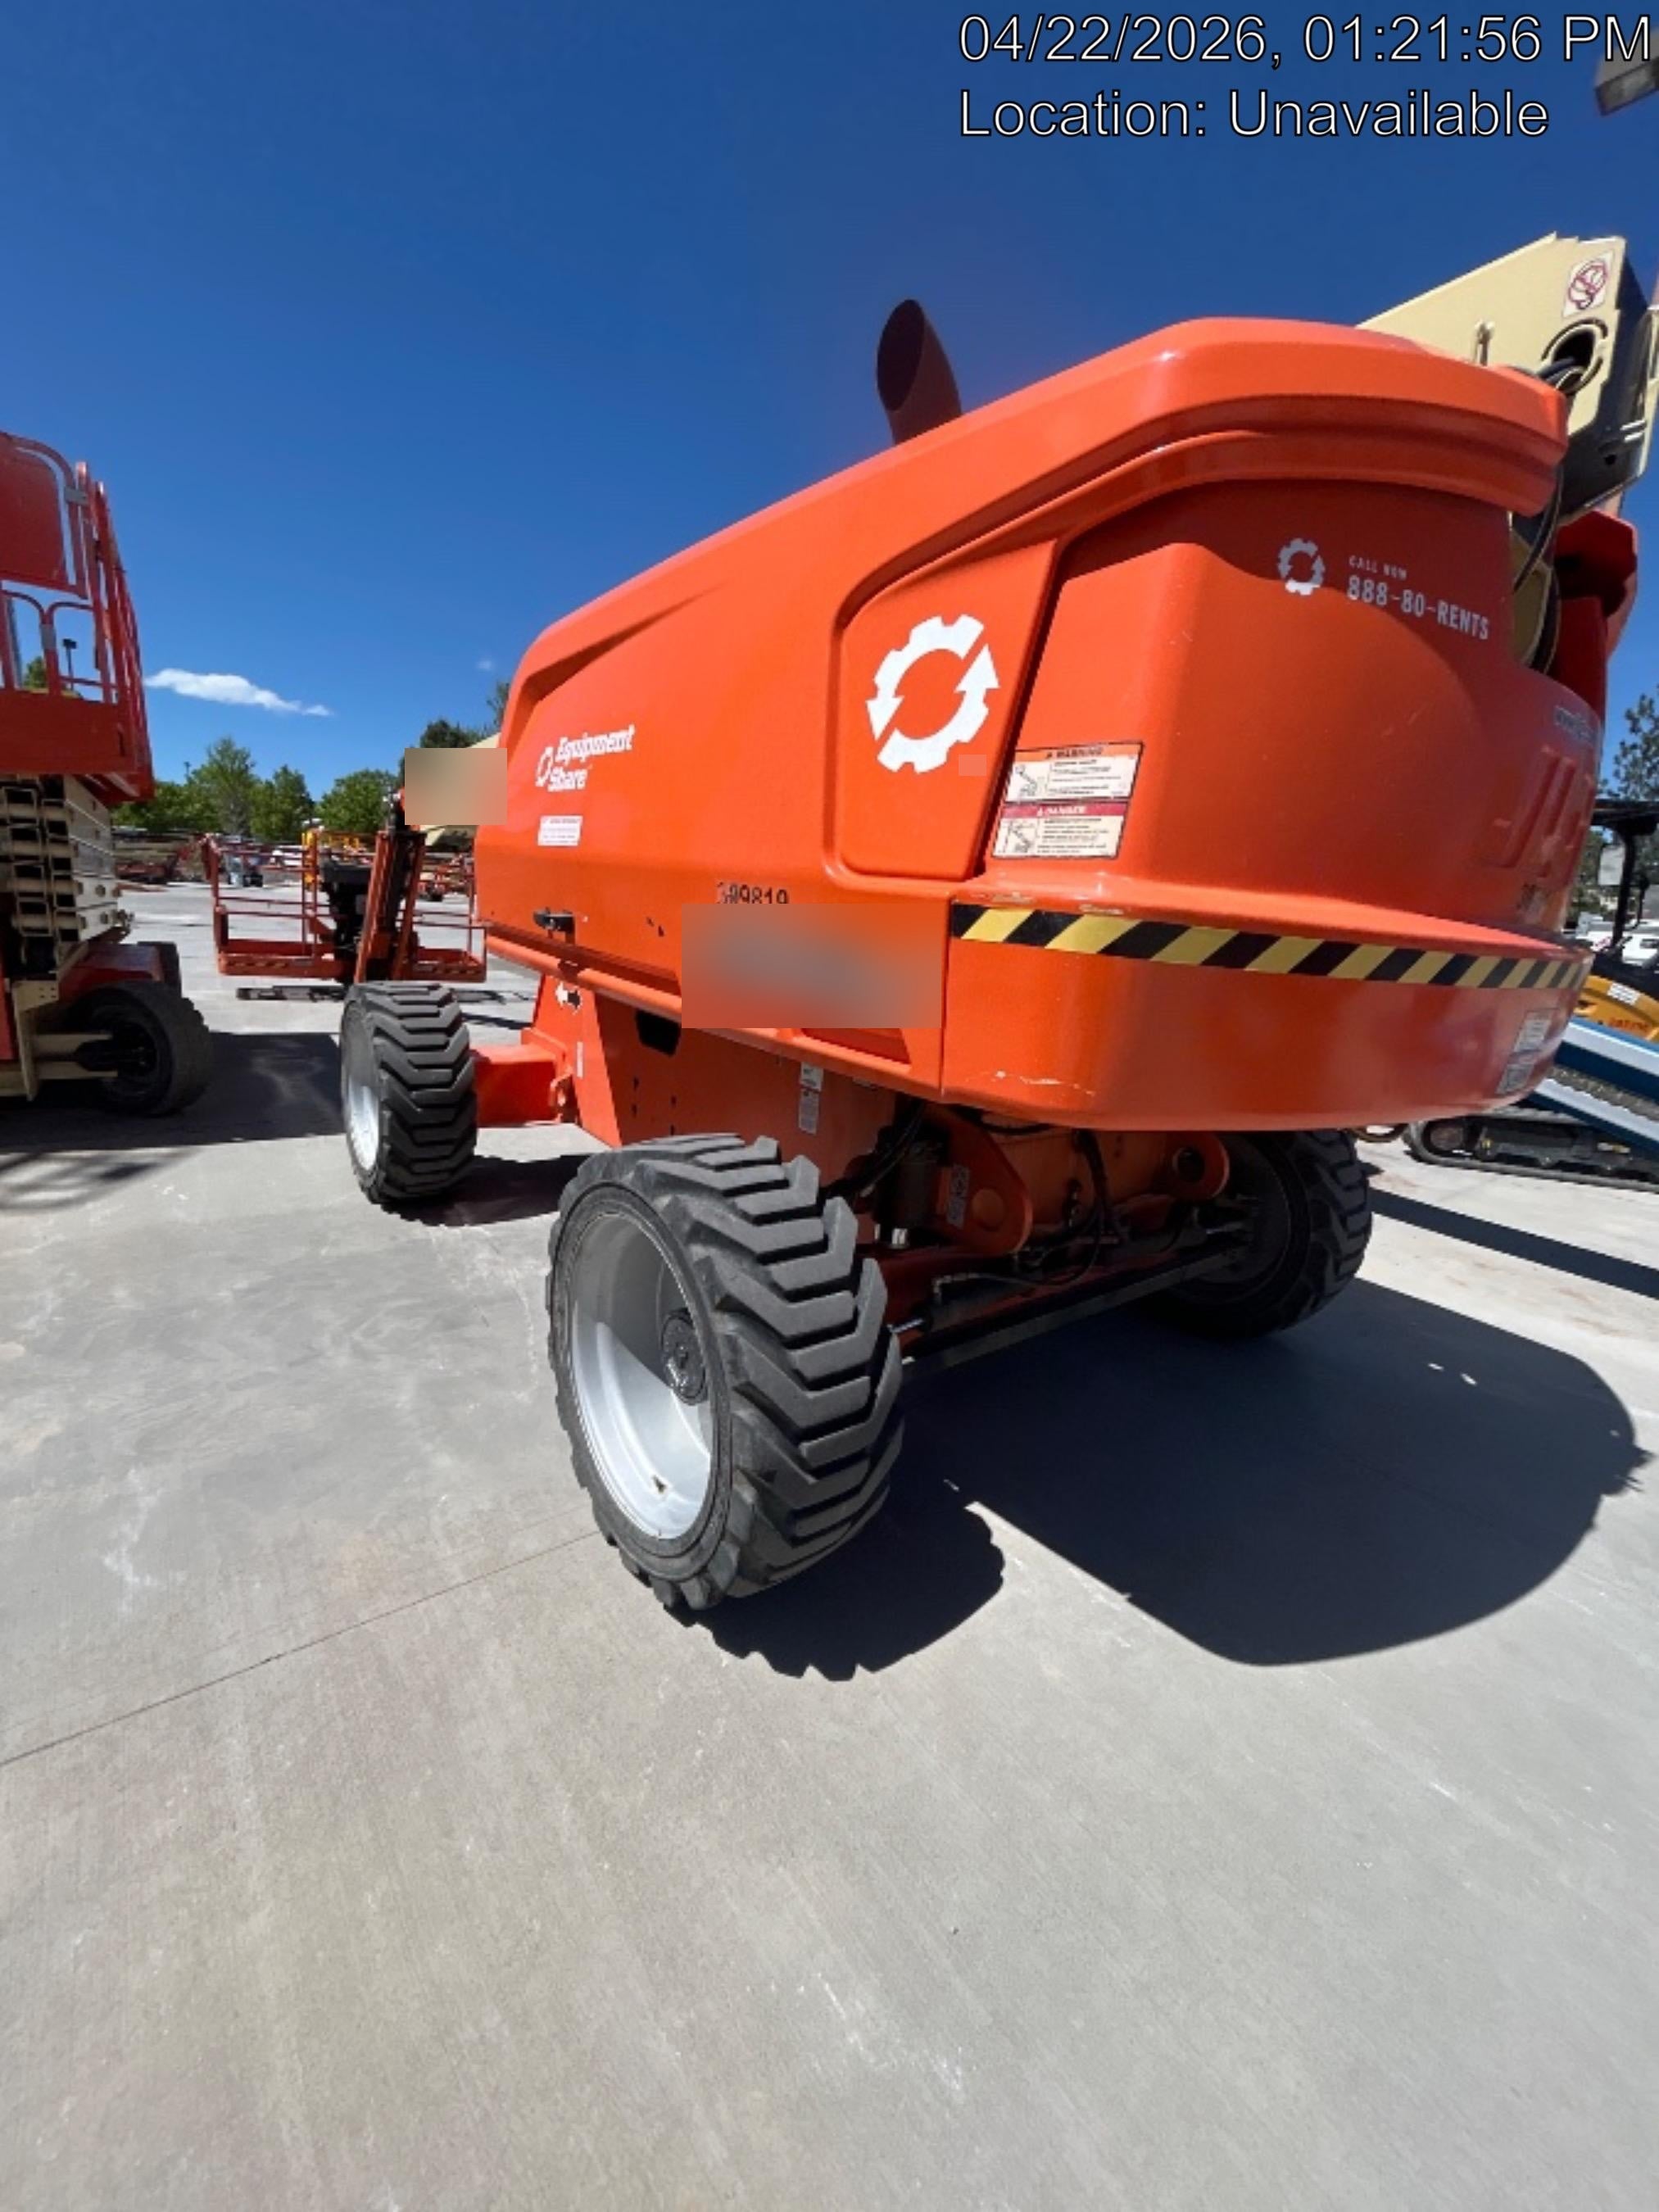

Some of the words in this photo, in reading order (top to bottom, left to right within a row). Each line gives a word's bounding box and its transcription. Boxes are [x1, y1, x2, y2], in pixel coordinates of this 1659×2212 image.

[1349, 555, 1378, 573] CALL
[1347, 574, 1489, 640] 888-80-RENTS
[555, 724, 636, 766] Equipment
[547, 766, 588, 792] Share
